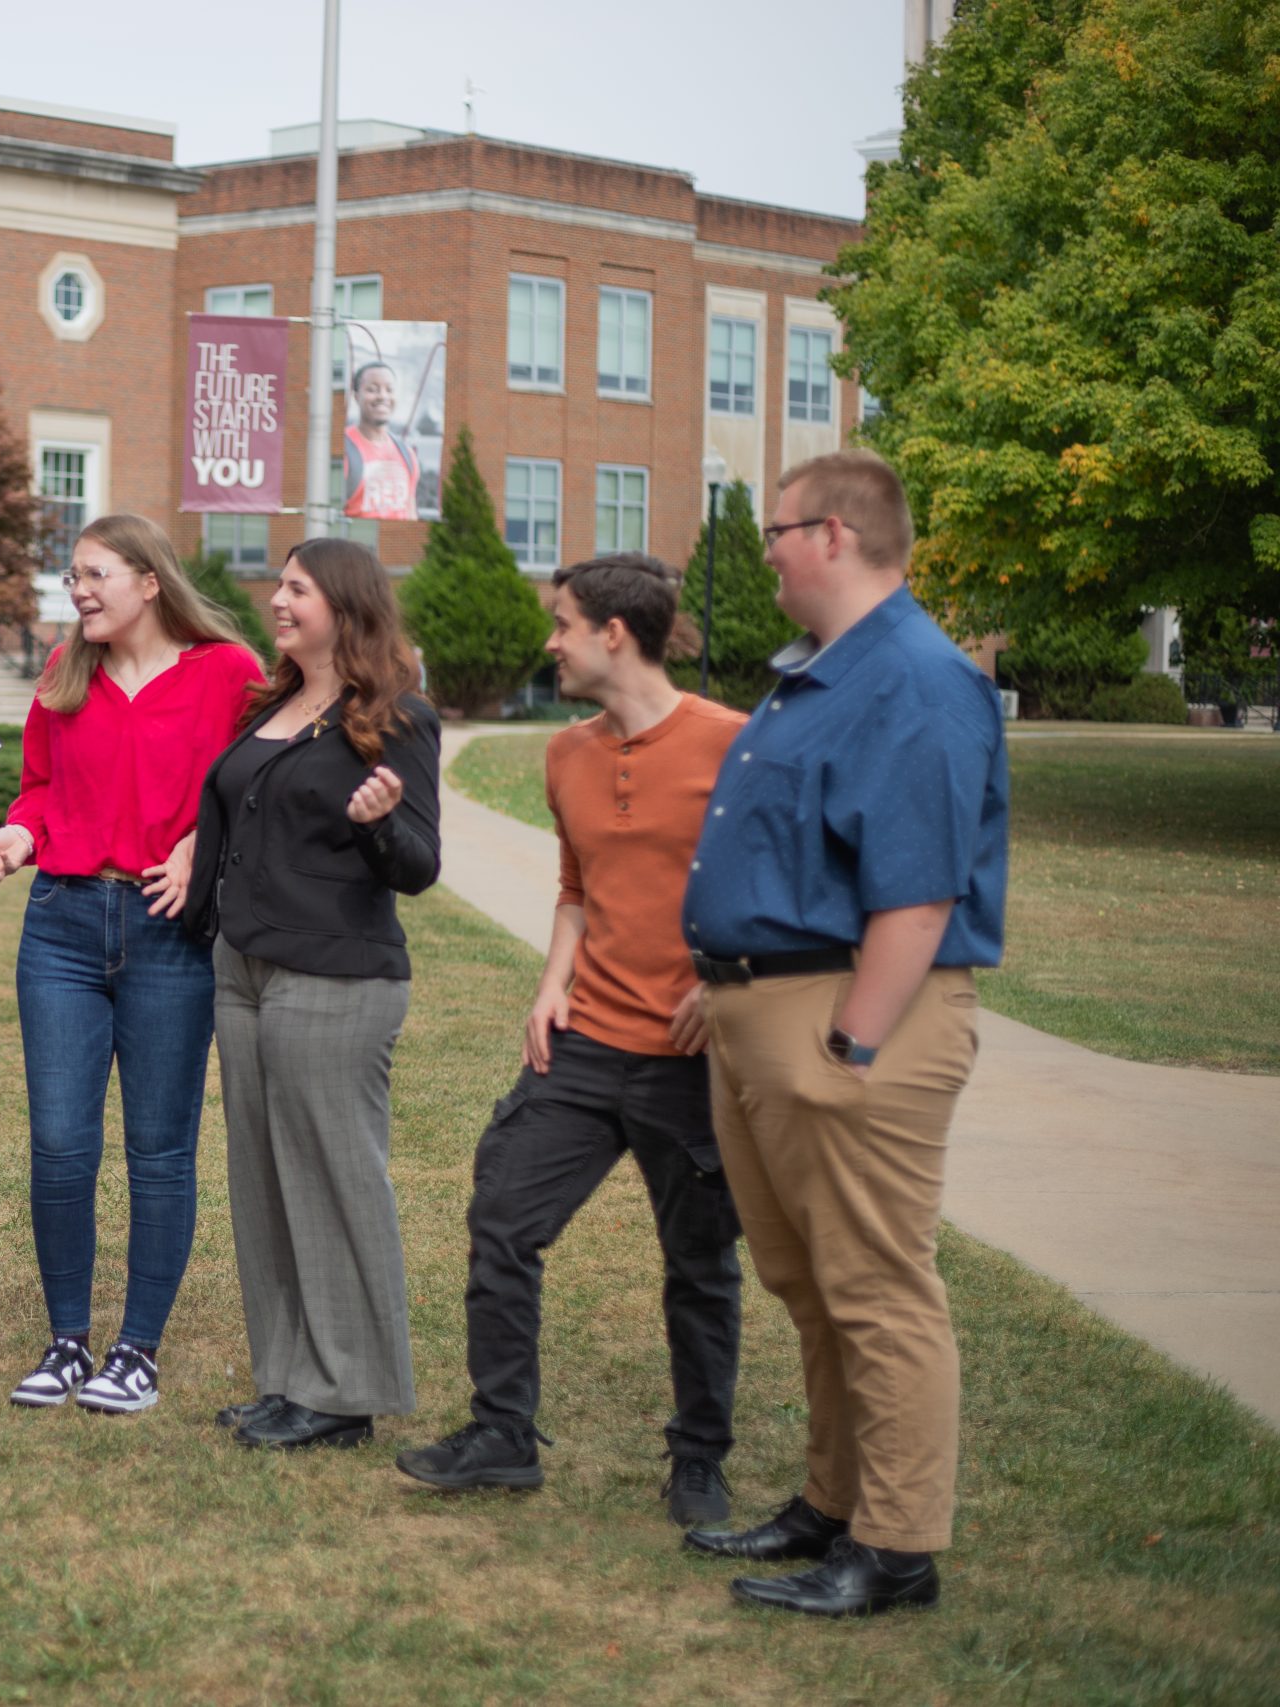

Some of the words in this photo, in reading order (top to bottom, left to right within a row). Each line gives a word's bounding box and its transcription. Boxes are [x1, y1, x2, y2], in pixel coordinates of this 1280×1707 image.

[196, 342, 240, 373] THE
[194, 371, 278, 404] FUTURE
[193, 399, 278, 433] STARTS
[193, 428, 250, 459] WITH
[191, 456, 265, 488] YOU
